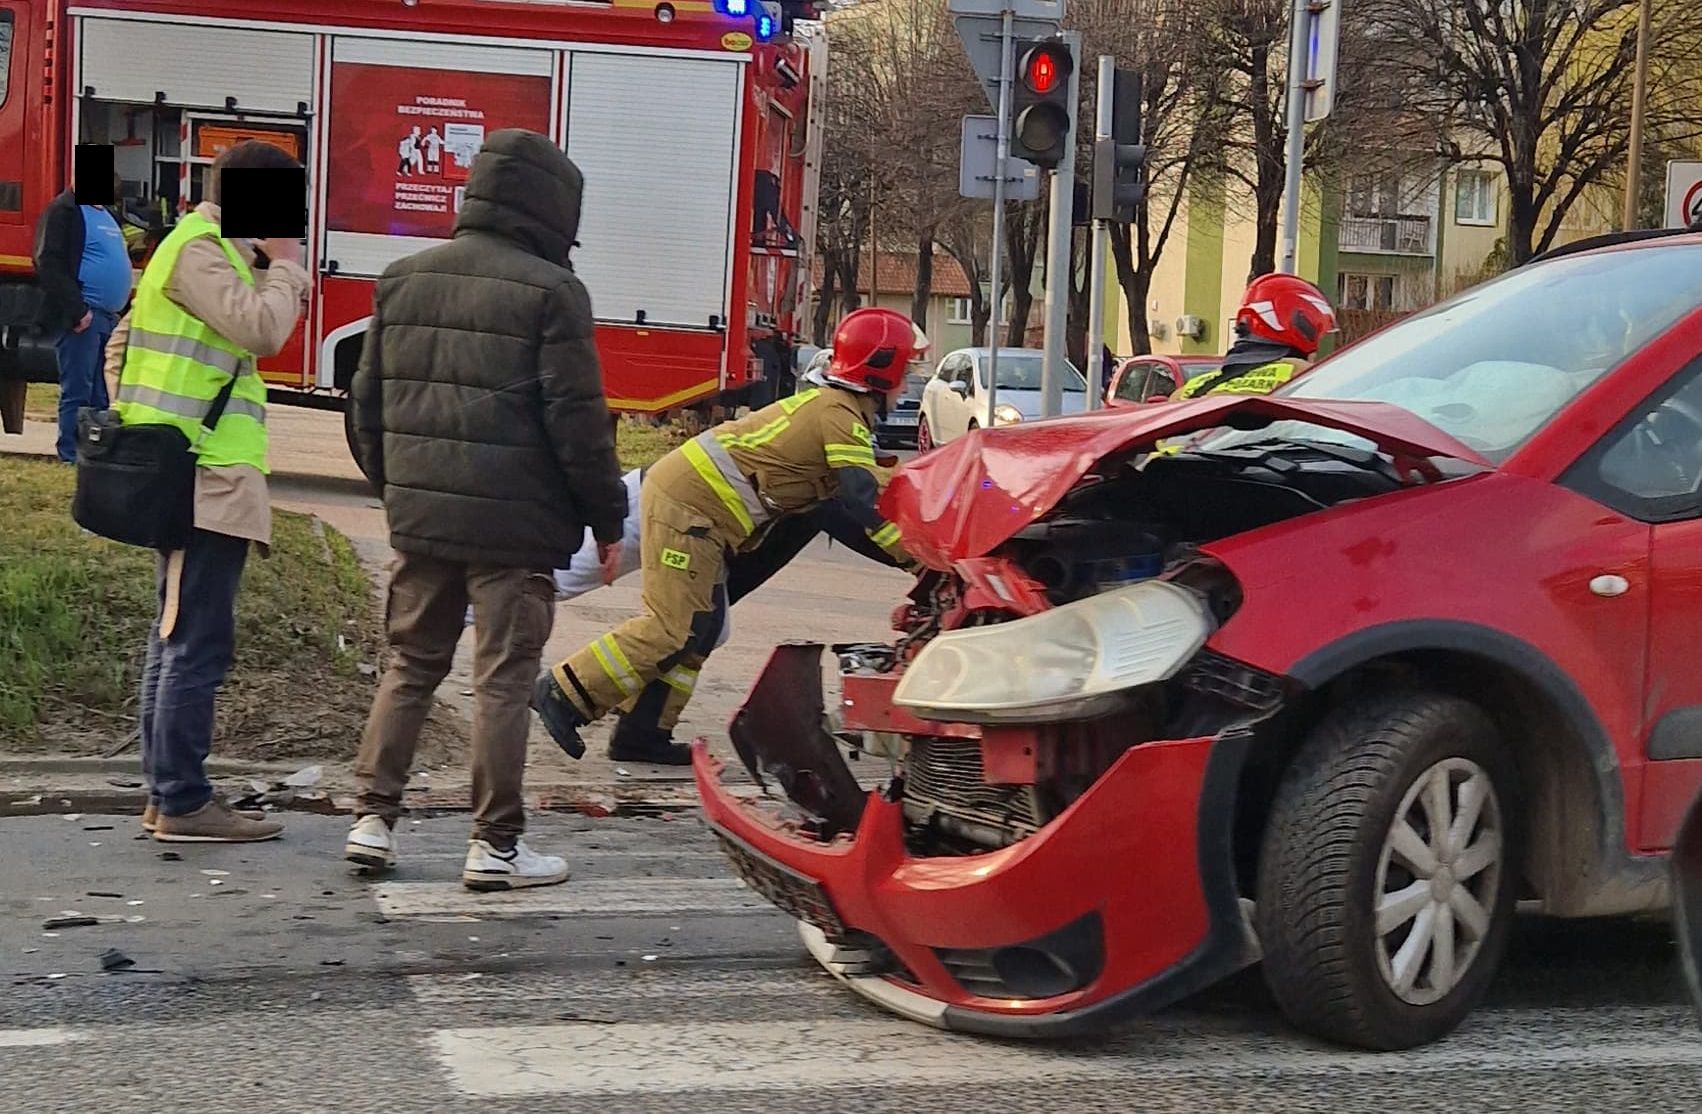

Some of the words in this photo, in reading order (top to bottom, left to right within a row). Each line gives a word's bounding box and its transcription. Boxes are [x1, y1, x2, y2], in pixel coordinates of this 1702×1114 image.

[416, 96, 466, 107] PORADNIK
[397, 105, 485, 119] BEZPIECZEŃSTWA
[395, 183, 453, 194] PRZECZYTAJ
[664, 552, 686, 566] PSP
